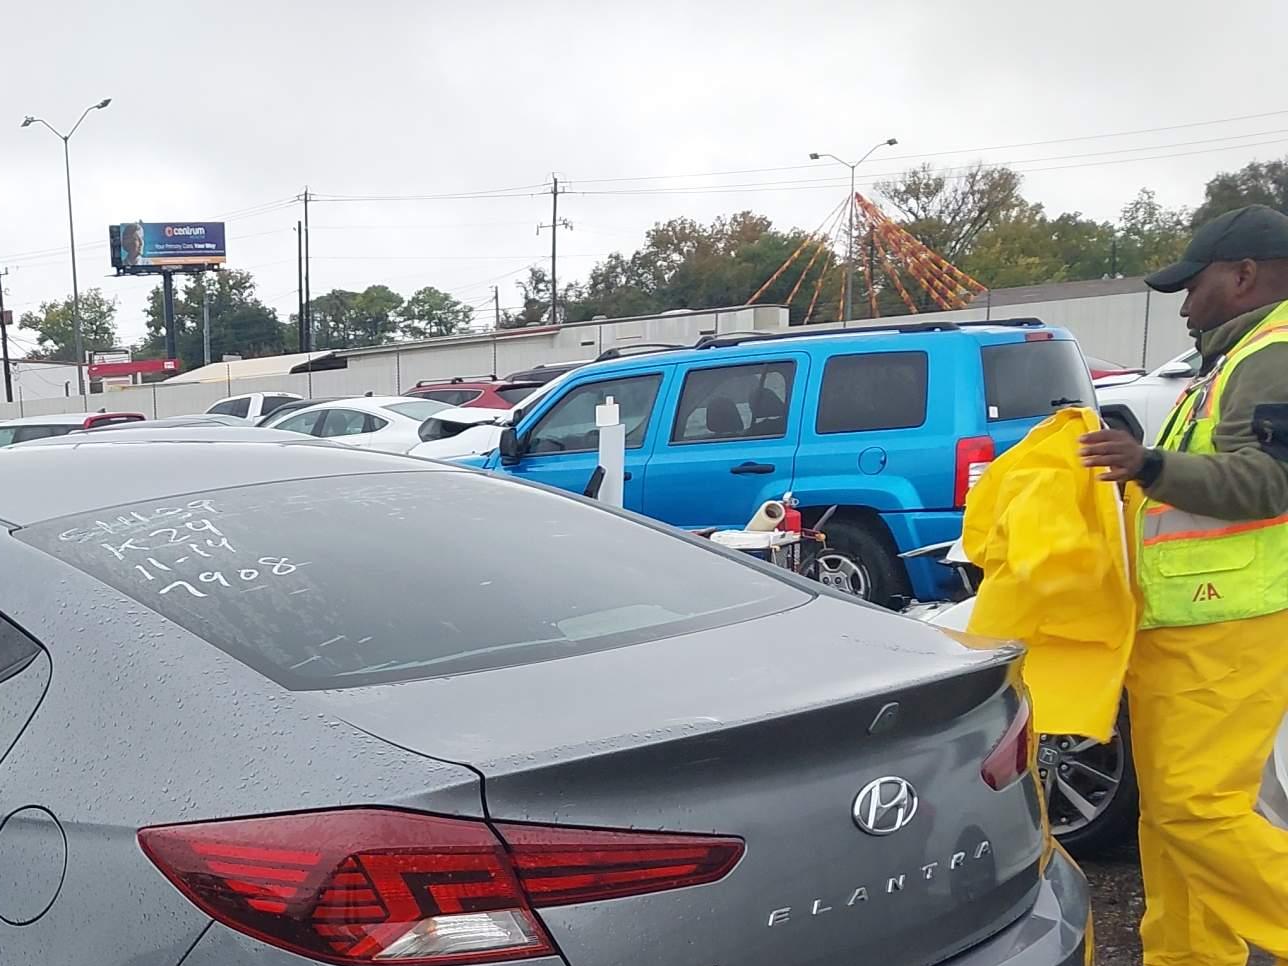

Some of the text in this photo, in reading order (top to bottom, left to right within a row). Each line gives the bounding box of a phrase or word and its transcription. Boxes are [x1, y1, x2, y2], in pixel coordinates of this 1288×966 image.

[174, 226, 205, 236] centrum
[159, 556, 297, 598] 7908
[767, 840, 992, 927] ELANTRA
